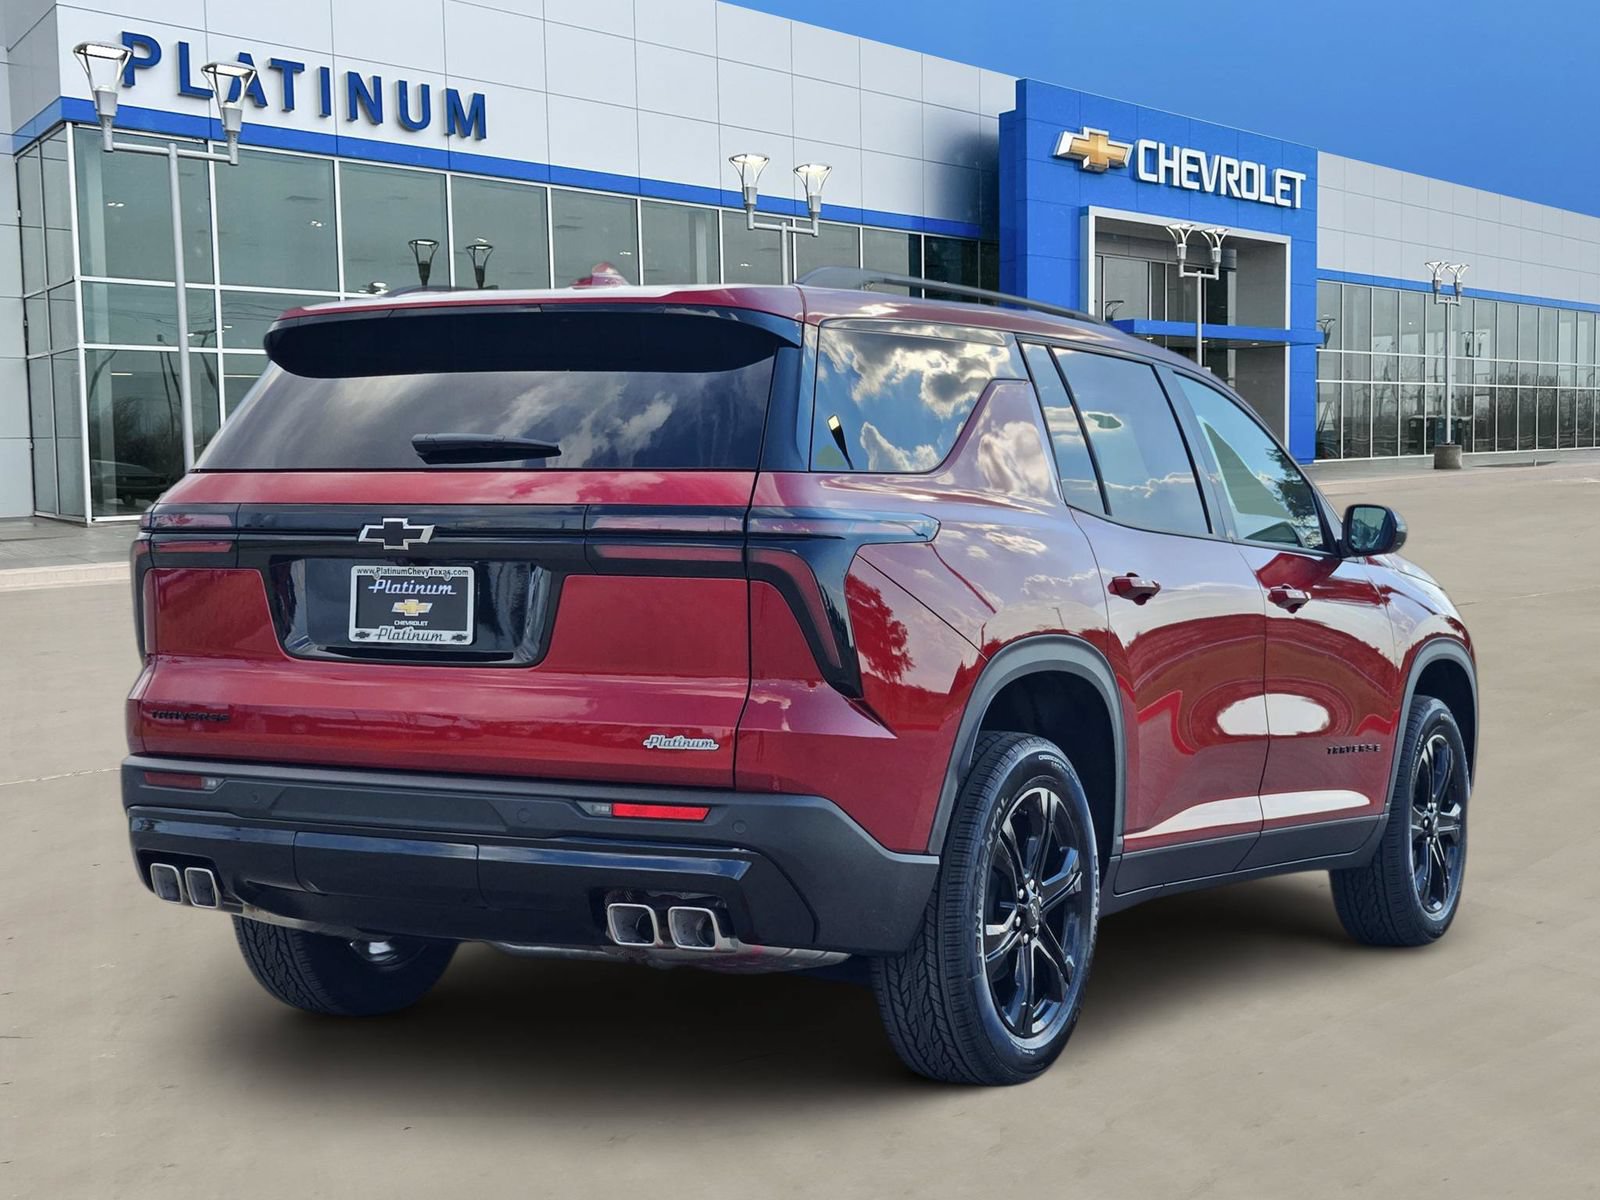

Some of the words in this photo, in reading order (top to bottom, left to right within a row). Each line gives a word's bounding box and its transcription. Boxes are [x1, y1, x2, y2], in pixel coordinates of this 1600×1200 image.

[121, 31, 487, 140] PLATINUM
[1136, 139, 1307, 208] CHEVROLET
[357, 567, 469, 577] www.PlatinumChevyTexas.com
[368, 580, 456, 595] Platinum
[374, 628, 446, 641] Platinum
[643, 735, 719, 750] Platinum
